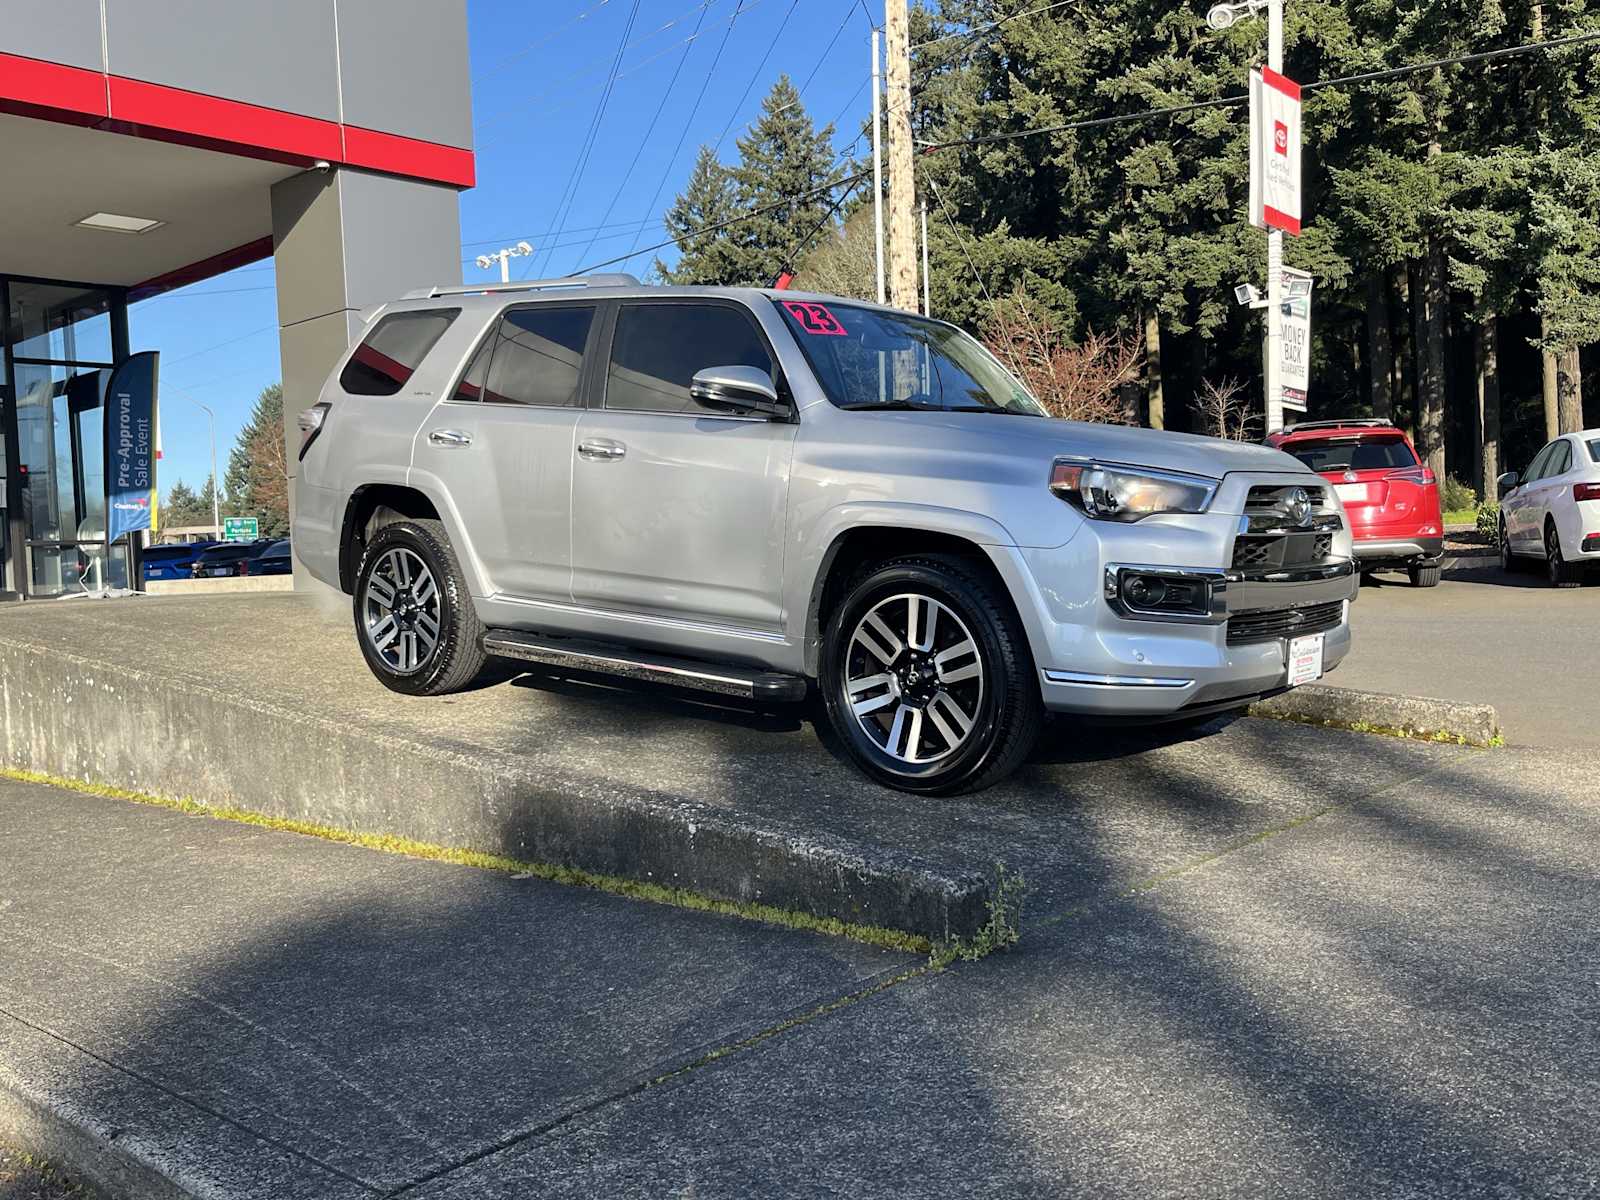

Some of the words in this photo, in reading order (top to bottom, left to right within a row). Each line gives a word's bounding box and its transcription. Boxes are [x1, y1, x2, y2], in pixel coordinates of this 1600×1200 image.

[787, 303, 839, 331] 23
[1280, 323, 1306, 346] MONEY
[1284, 343, 1302, 364] BACK
[117, 393, 133, 487] Pre-Approval
[135, 417, 148, 455] Event
[134, 459, 148, 487] Sale
